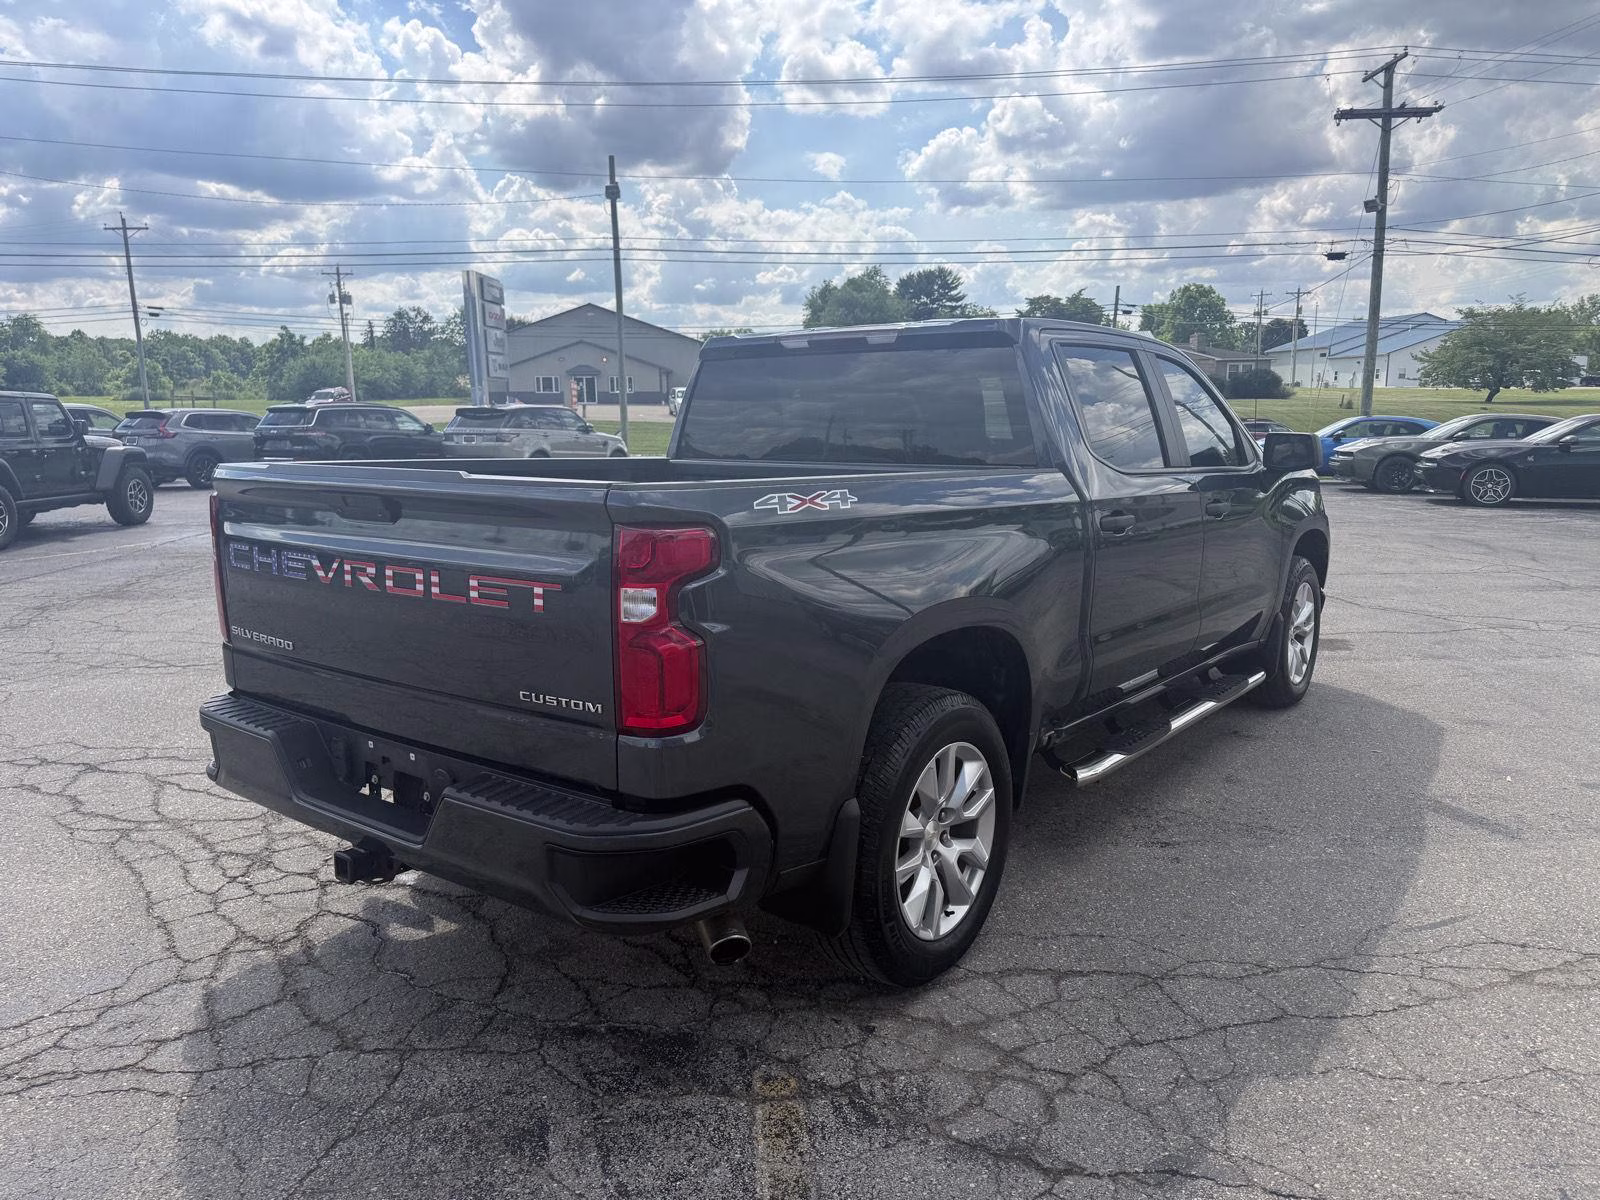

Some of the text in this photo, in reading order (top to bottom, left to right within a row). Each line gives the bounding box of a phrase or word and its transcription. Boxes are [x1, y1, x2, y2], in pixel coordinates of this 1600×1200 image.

[753, 489, 858, 514] 4X4
[229, 543, 562, 613] CHEVROLET
[231, 625, 294, 651] SILVERADO
[519, 690, 602, 714] CUSTOM
